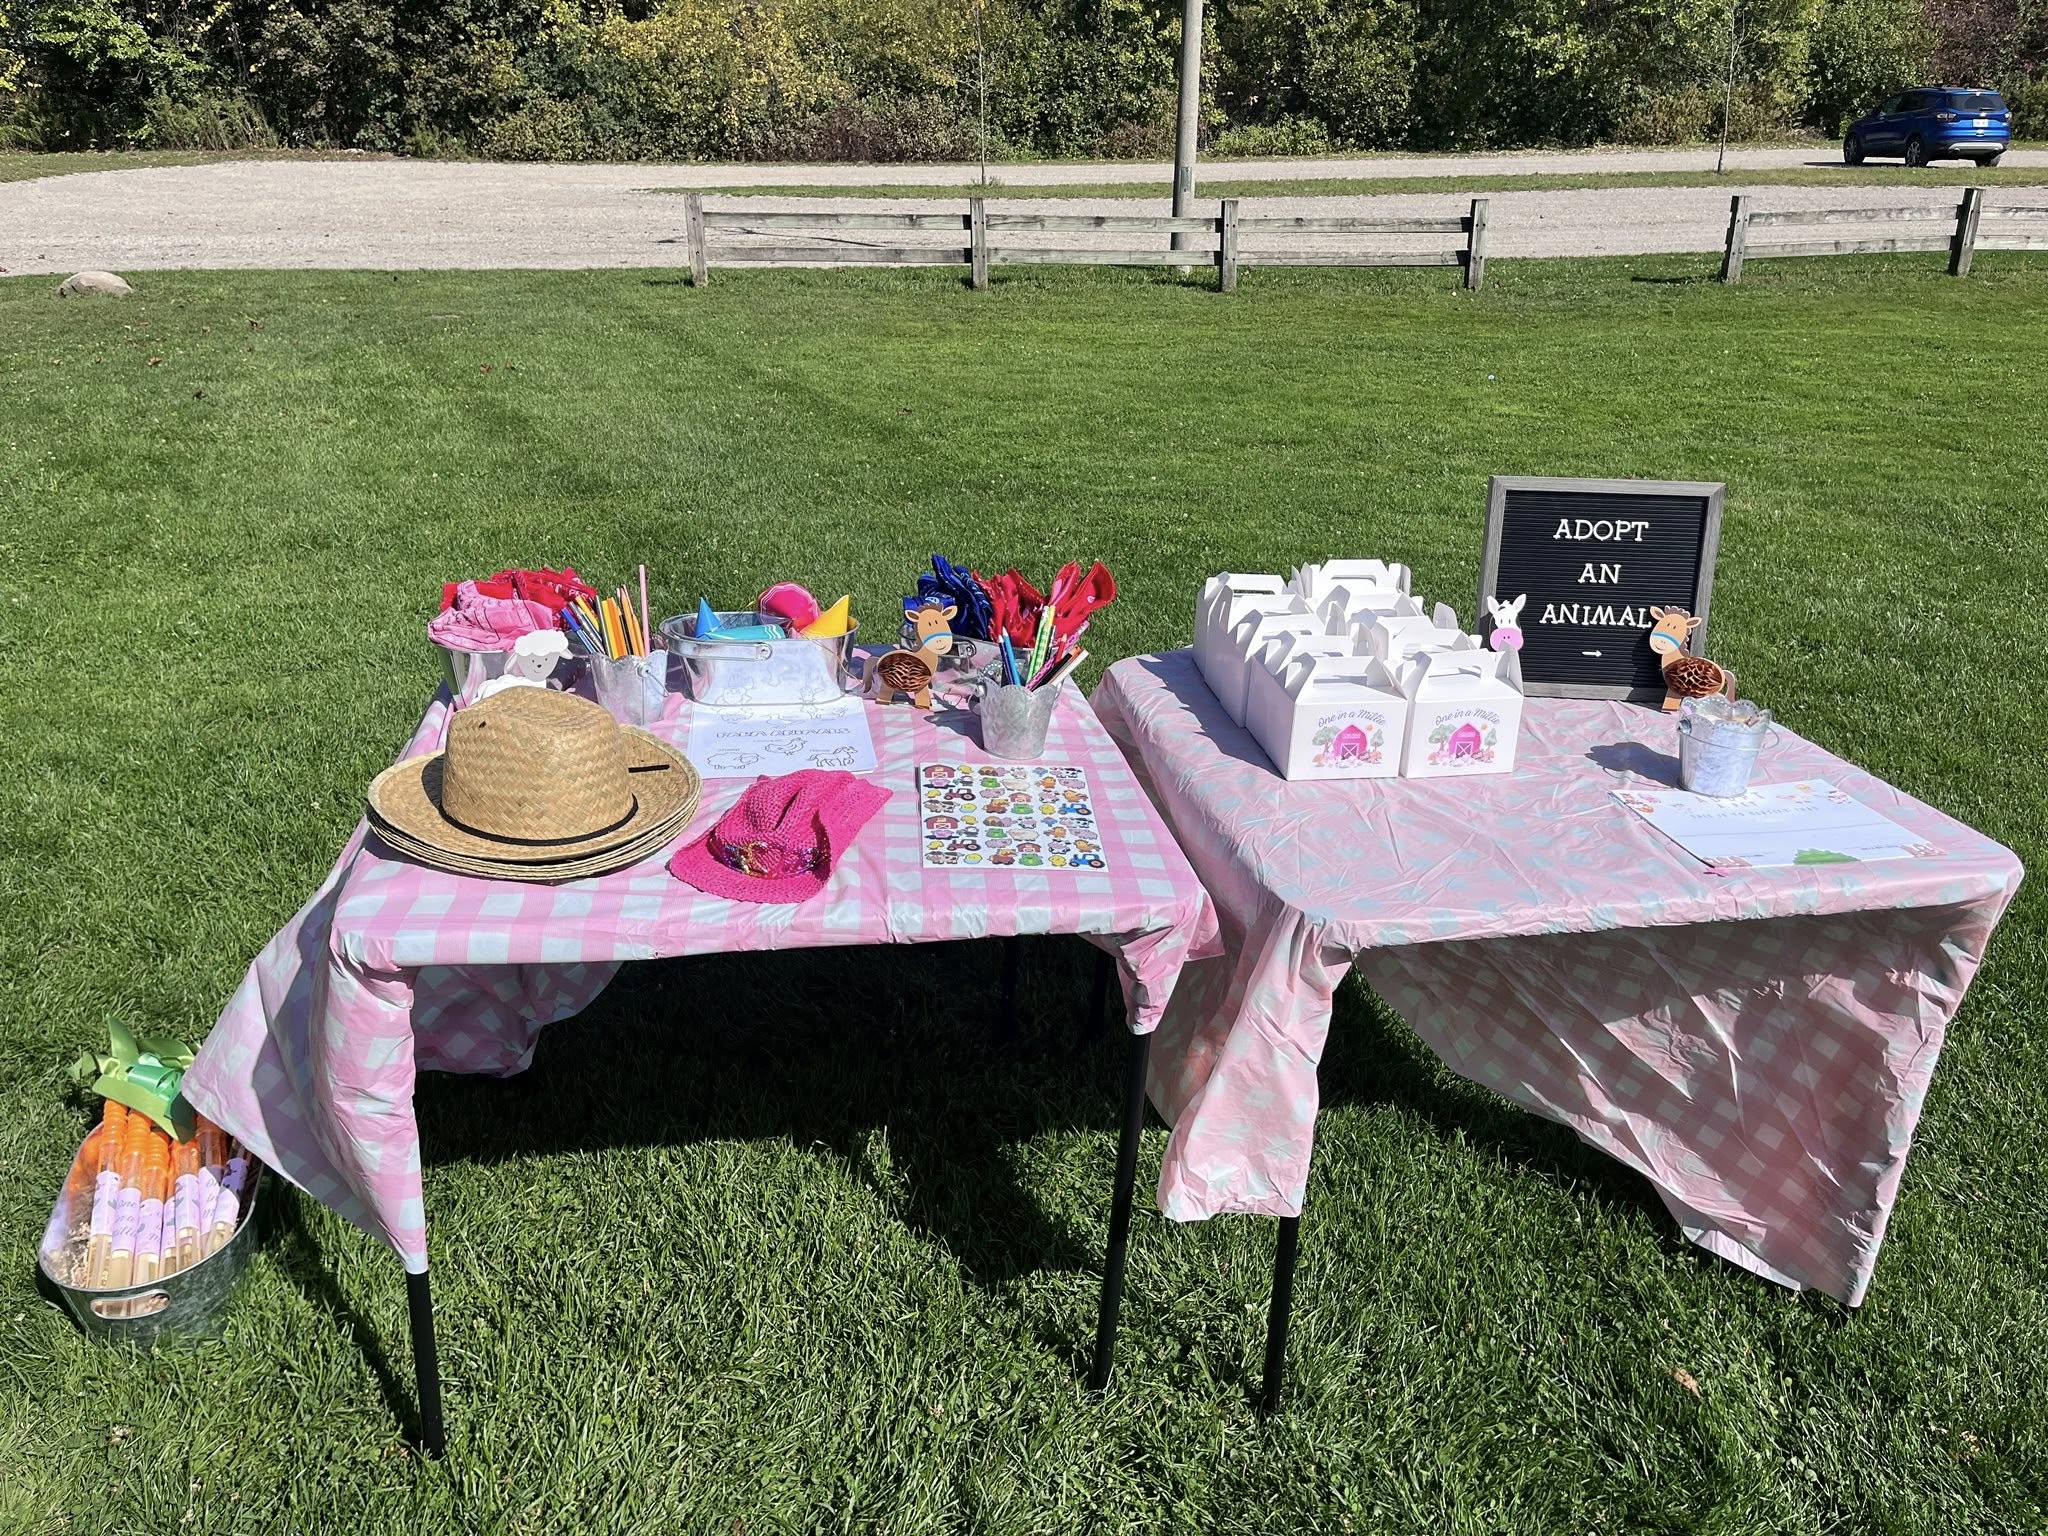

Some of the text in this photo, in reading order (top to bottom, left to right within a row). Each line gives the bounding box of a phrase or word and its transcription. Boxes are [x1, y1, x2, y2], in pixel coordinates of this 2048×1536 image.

[1553, 518, 1649, 542] ADOPT
[1577, 563, 1621, 584] AN
[1539, 603, 1652, 628] ANIMAL
[1318, 714, 1336, 727] One
[1337, 710, 1347, 720] in
[1357, 709, 1385, 725] Millie
[1435, 713, 1453, 726] One
[1454, 709, 1463, 719] in
[1473, 708, 1500, 724] Millie
